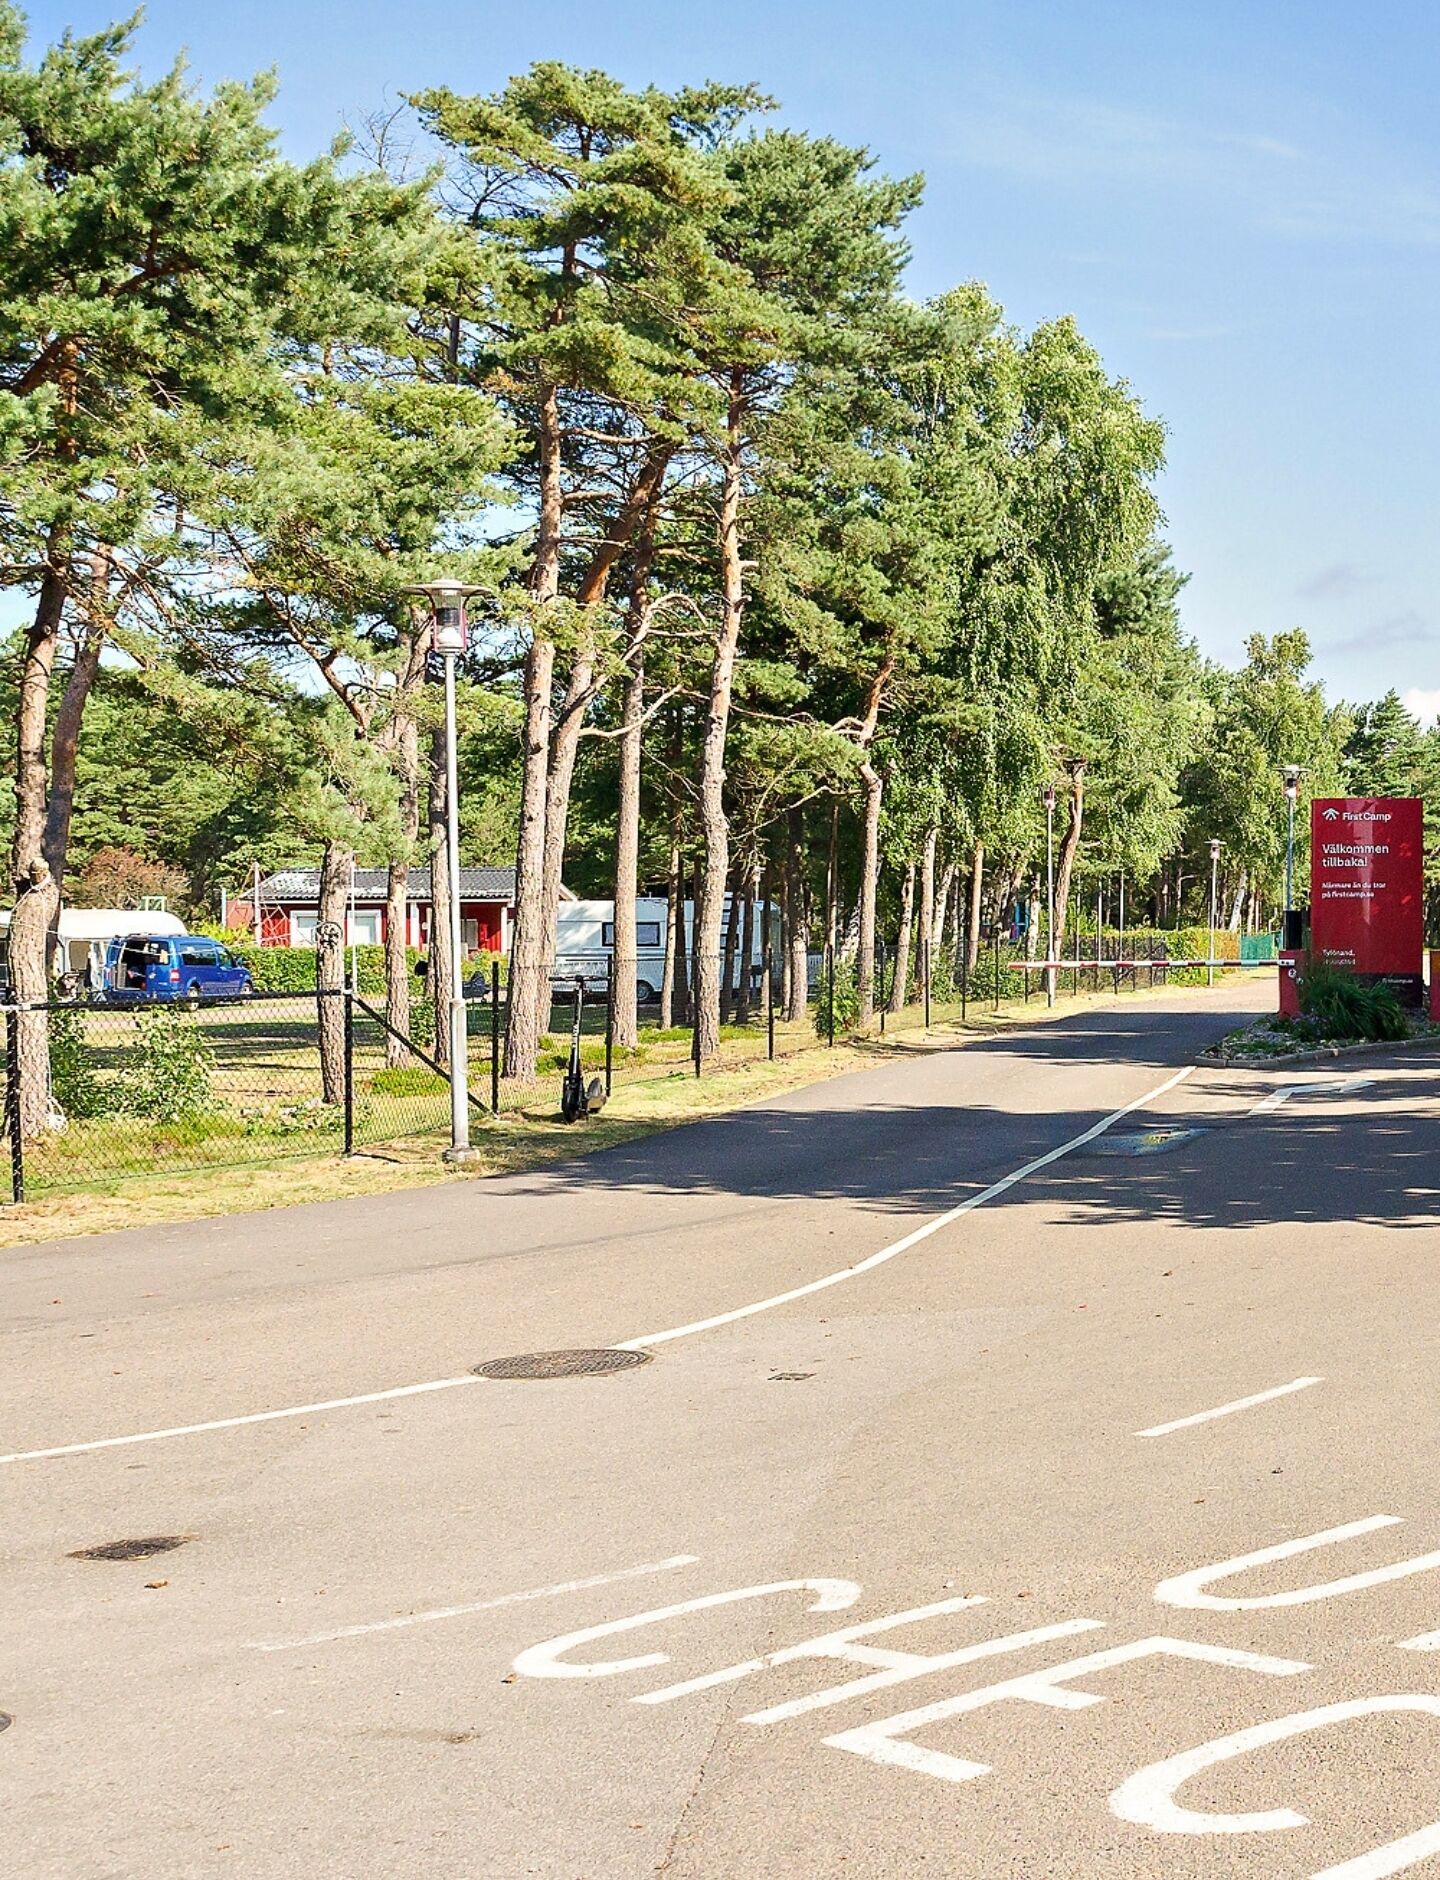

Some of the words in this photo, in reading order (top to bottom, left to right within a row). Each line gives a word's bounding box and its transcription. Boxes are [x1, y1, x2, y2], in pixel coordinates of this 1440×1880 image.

[1342, 812, 1362, 821] First
[1363, 812, 1392, 823] Camp
[1322, 843, 1389, 854] Välkommen
[1322, 856, 1368, 867] tillbaka!
